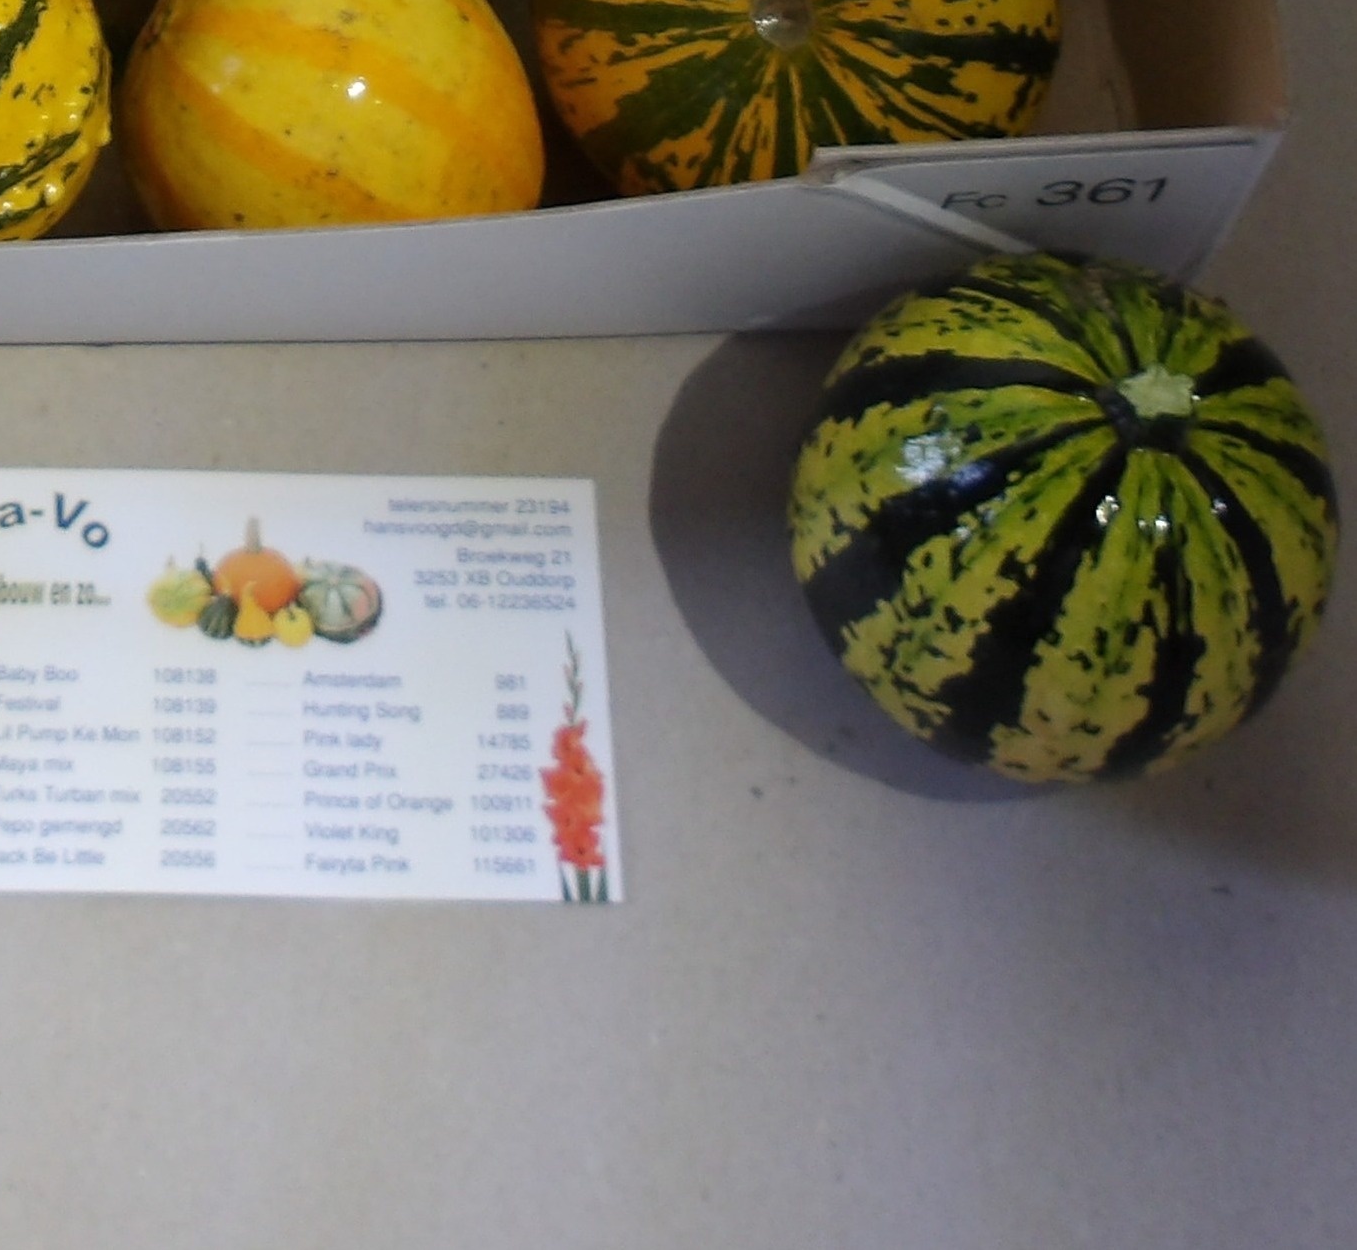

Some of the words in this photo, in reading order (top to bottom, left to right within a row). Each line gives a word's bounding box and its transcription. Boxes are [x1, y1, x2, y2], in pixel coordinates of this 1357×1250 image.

[1036, 177, 1168, 207] 361
[514, 498, 571, 514] 23194
[363, 519, 573, 538] hansvoogd@gmail.com
[456, 547, 546, 568] Broekweg
[551, 549, 572, 565] 21
[495, 570, 577, 590] Ouddorp
[51, 581, 72, 605] en
[43, 664, 80, 682] Boo
[302, 670, 403, 689] Amsterdam
[302, 701, 370, 723] Hunting
[375, 701, 422, 724] Song
[16, 723, 69, 743] Pump
[72, 725, 98, 742] Ke
[303, 729, 341, 746] Pink
[345, 731, 383, 751] lady
[43, 756, 75, 772] mix
[302, 759, 357, 778] Grand
[363, 760, 398, 778] Prix
[44, 784, 106, 803] Turban
[109, 787, 142, 803] mix
[303, 790, 360, 809] Prince
[364, 791, 383, 810] of
[386, 791, 454, 815] Orange
[40, 817, 123, 838] gemengd
[303, 821, 354, 840] Violet
[358, 822, 400, 845] King
[32, 847, 58, 865] Be
[62, 847, 106, 866] Little
[371, 853, 411, 872] Pink
